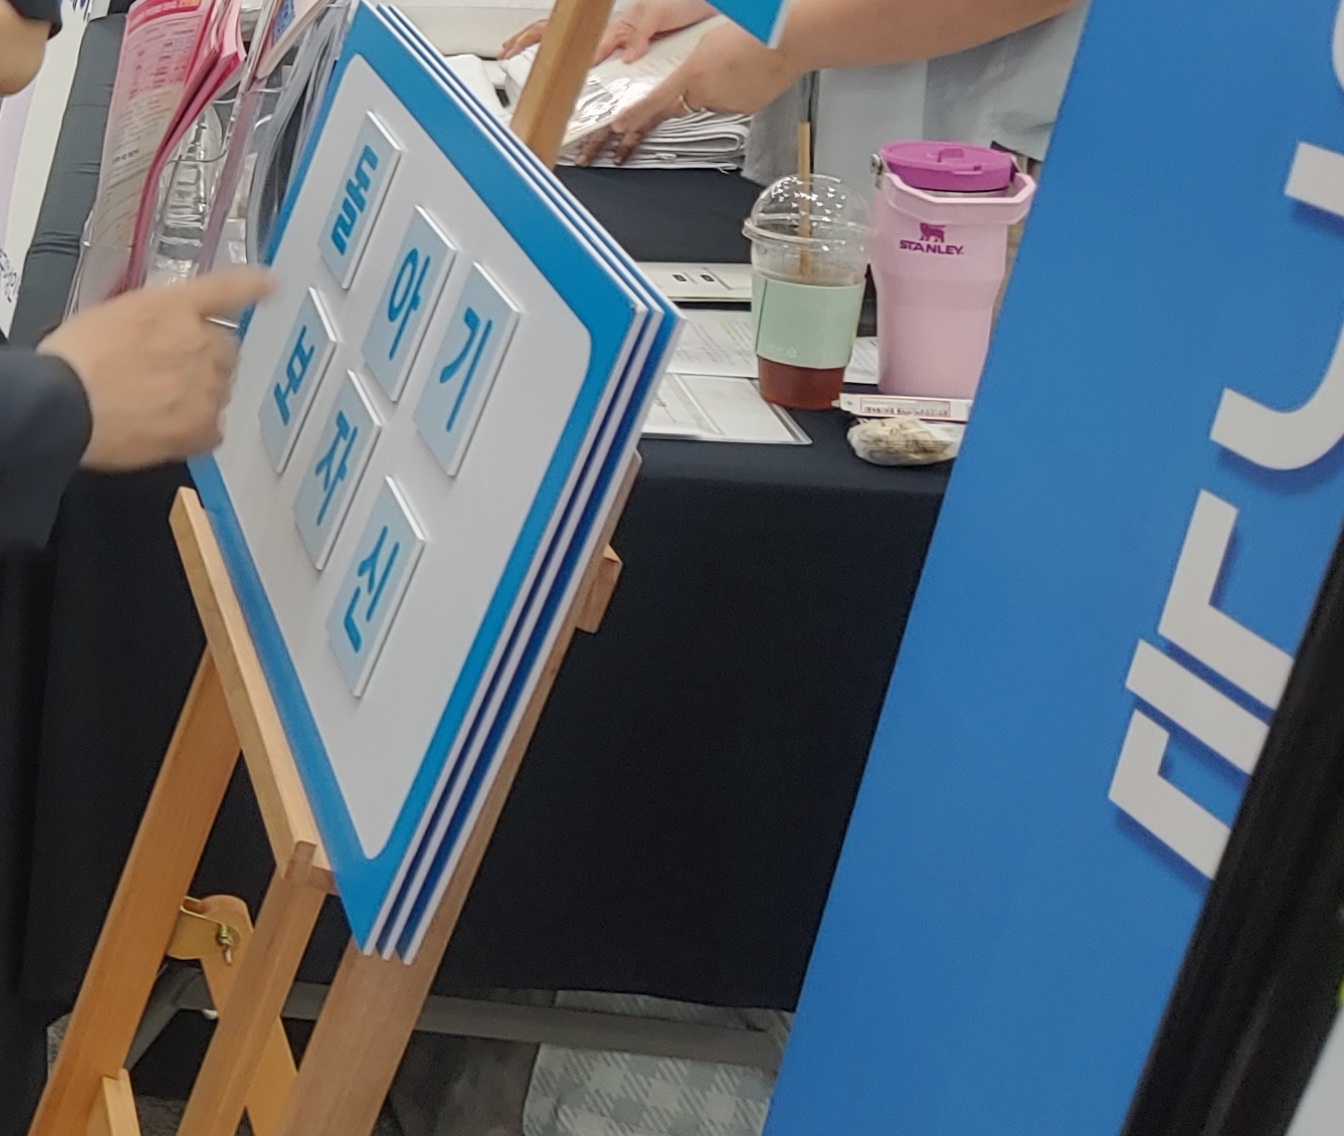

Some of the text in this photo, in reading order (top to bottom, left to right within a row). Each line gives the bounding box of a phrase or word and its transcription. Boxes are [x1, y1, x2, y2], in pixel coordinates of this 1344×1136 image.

[330, 144, 493, 433] 돌 아 기
[899, 239, 963, 255] STANLEY
[273, 325, 400, 654] 보 자 신
